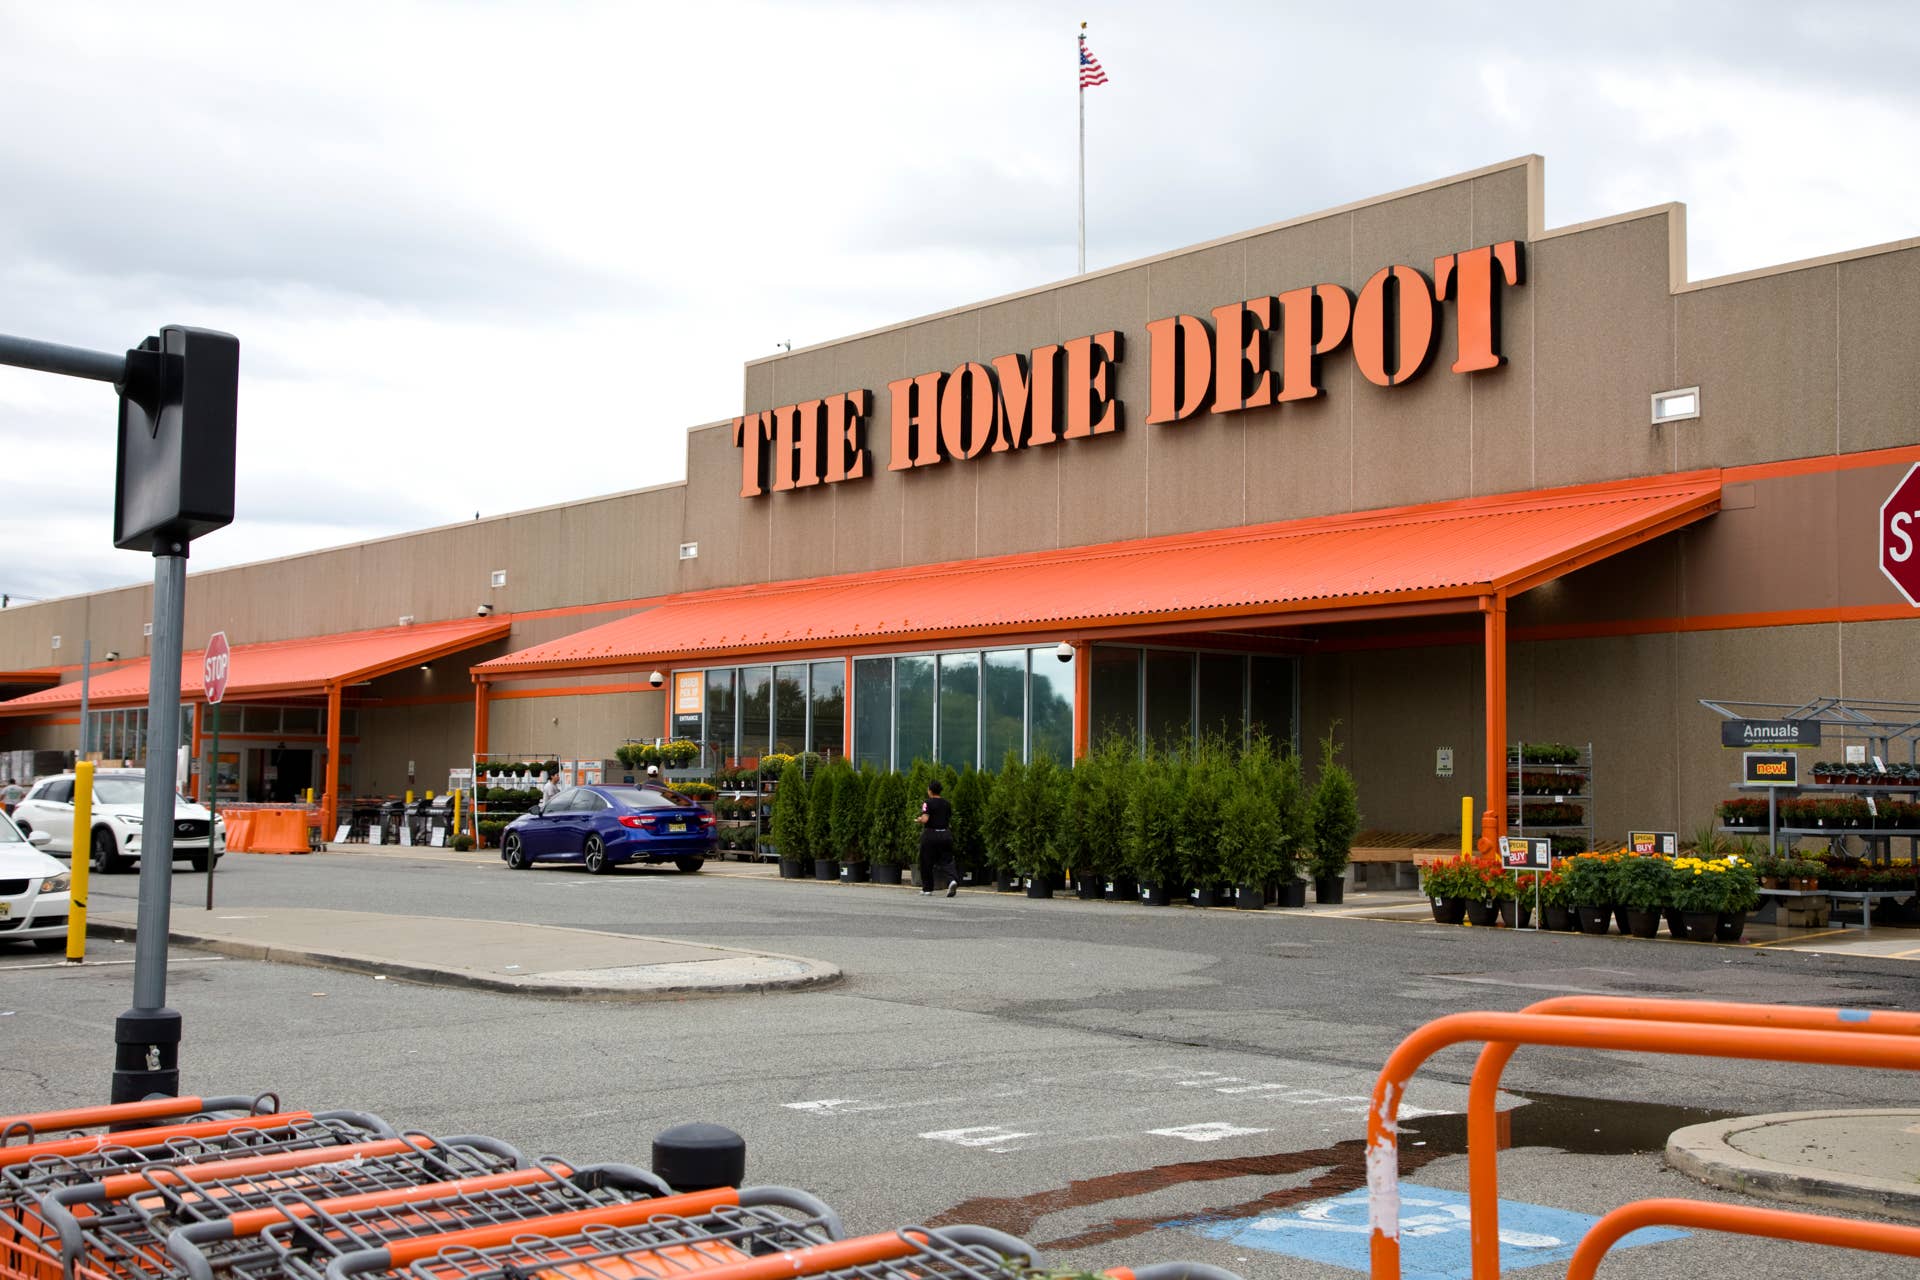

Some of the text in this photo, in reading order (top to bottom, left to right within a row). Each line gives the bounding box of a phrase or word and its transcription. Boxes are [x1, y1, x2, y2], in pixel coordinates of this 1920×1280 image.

[732, 240, 1525, 498] THE HOME DEPOT
[1889, 510, 1920, 562] S
[205, 653, 228, 682] STOP
[1743, 724, 1799, 738] Annuals
[1756, 761, 1787, 775] new!
[1508, 841, 1527, 849] PECIAL
[1634, 834, 1655, 842] SPECIAL
[1636, 844, 1653, 852] BUY
[1509, 851, 1526, 862] BUY
